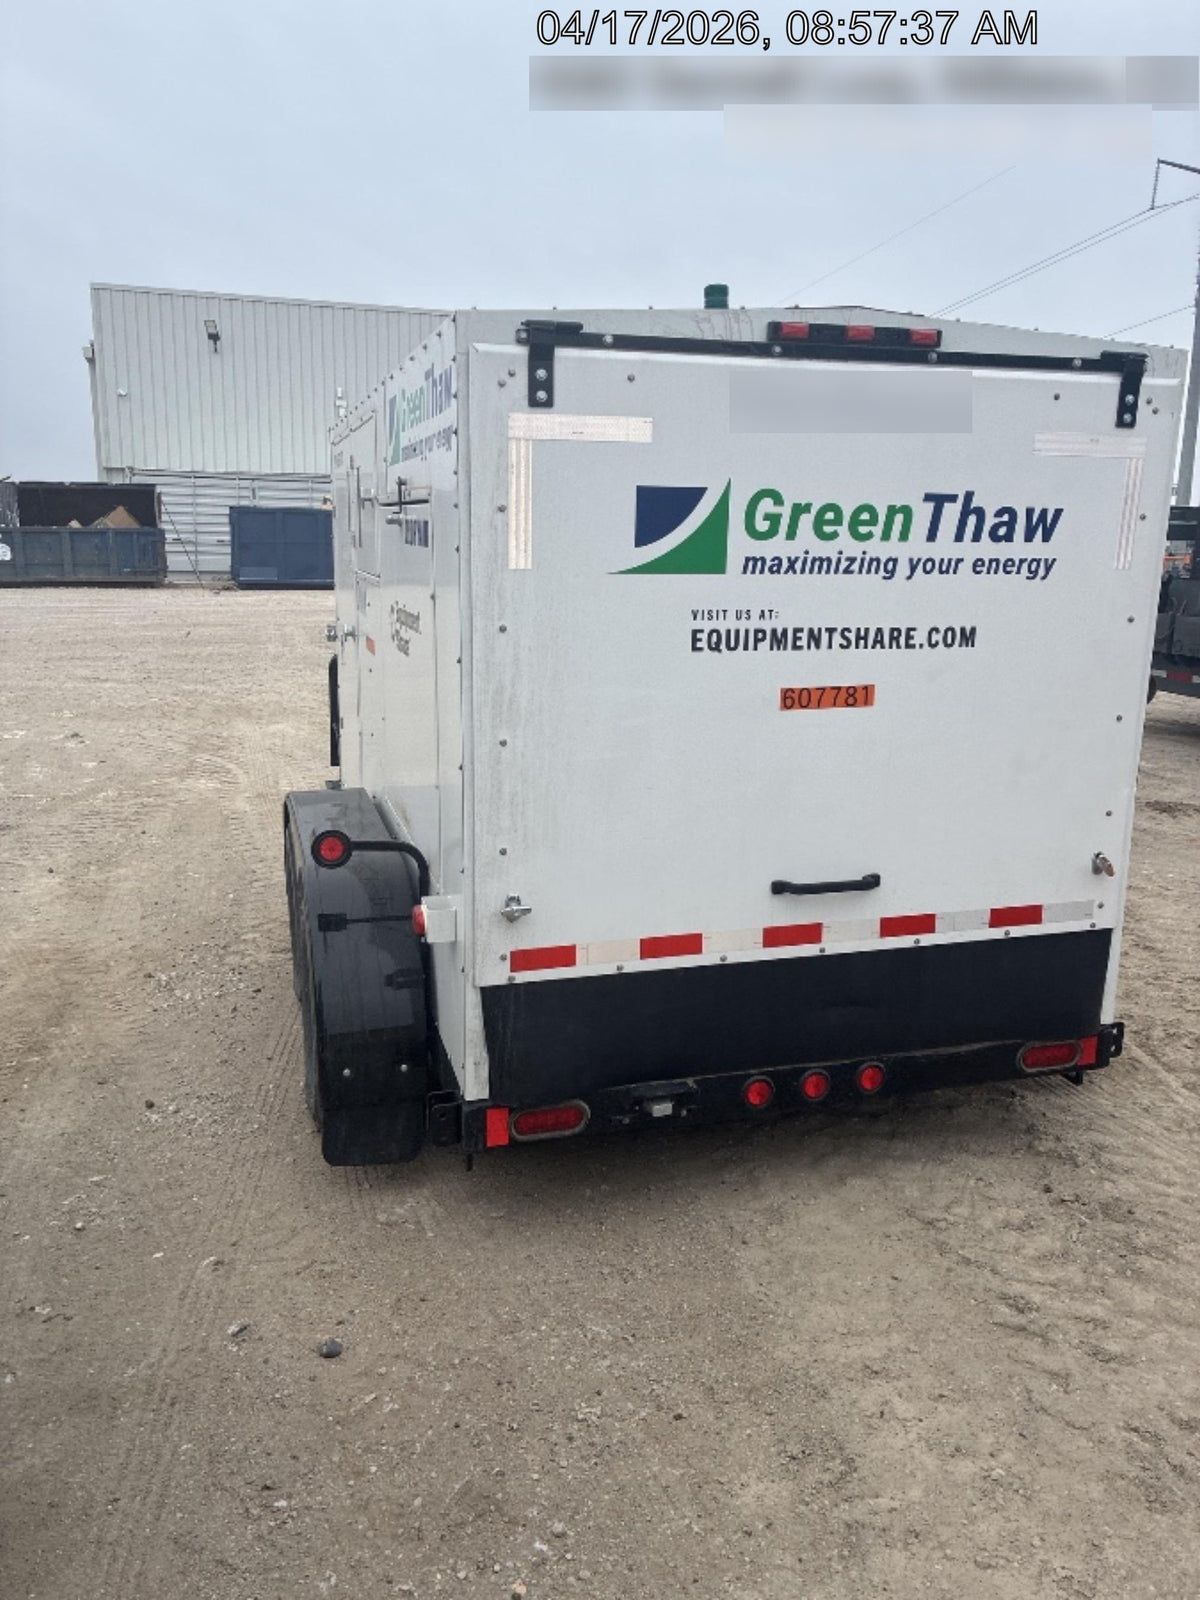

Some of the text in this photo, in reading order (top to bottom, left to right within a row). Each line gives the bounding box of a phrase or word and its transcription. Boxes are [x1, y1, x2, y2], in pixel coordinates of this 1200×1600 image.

[743, 487, 1064, 544] GreenThaw
[741, 549, 1058, 581] maximizing your energy
[690, 609, 780, 622] VISIT US AT:
[690, 625, 977, 654] EQUIPMENTSHARE.COM
[782, 685, 870, 710] 607781
